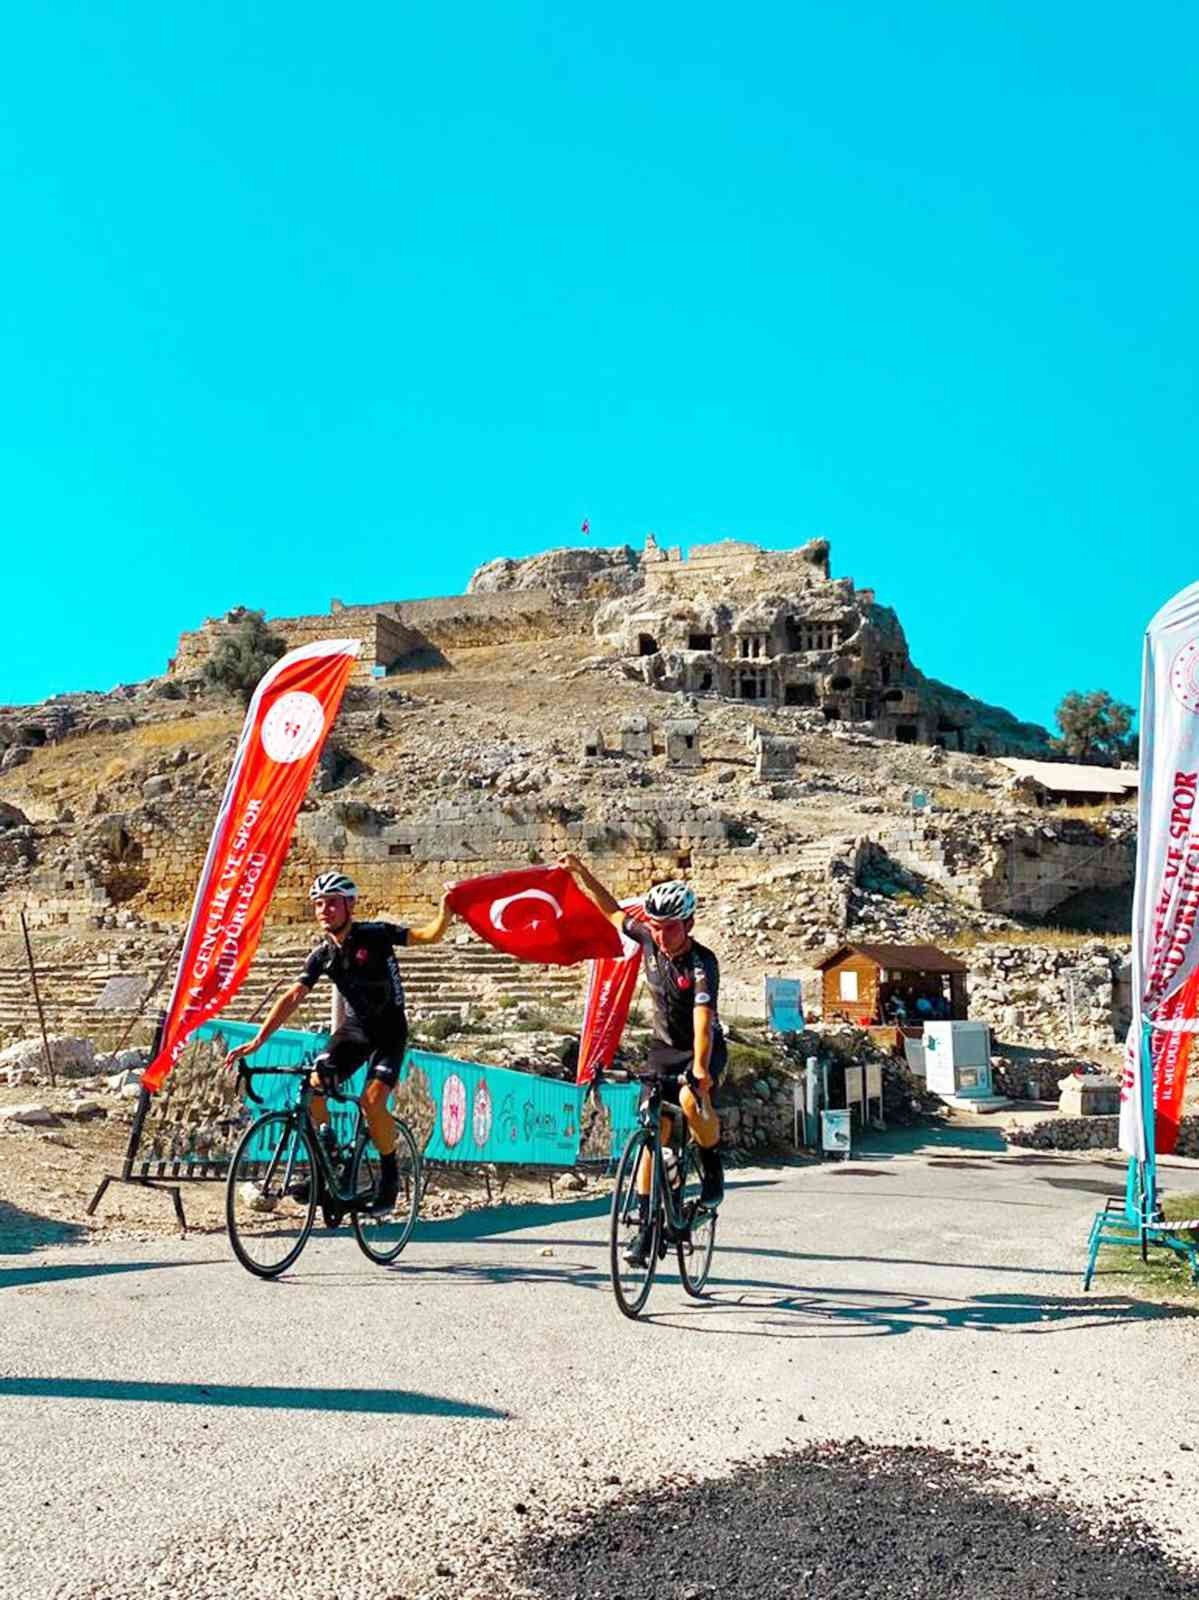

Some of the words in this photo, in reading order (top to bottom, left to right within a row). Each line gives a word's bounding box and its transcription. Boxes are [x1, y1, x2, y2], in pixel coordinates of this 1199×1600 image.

[1169, 771, 1198, 841] SPOR
[192, 887, 232, 980] GENÇLİK
[222, 853, 244, 880] VE
[233, 799, 262, 851] SPOR
[218, 852, 266, 991] MÜDÜRLÜĞÜ
